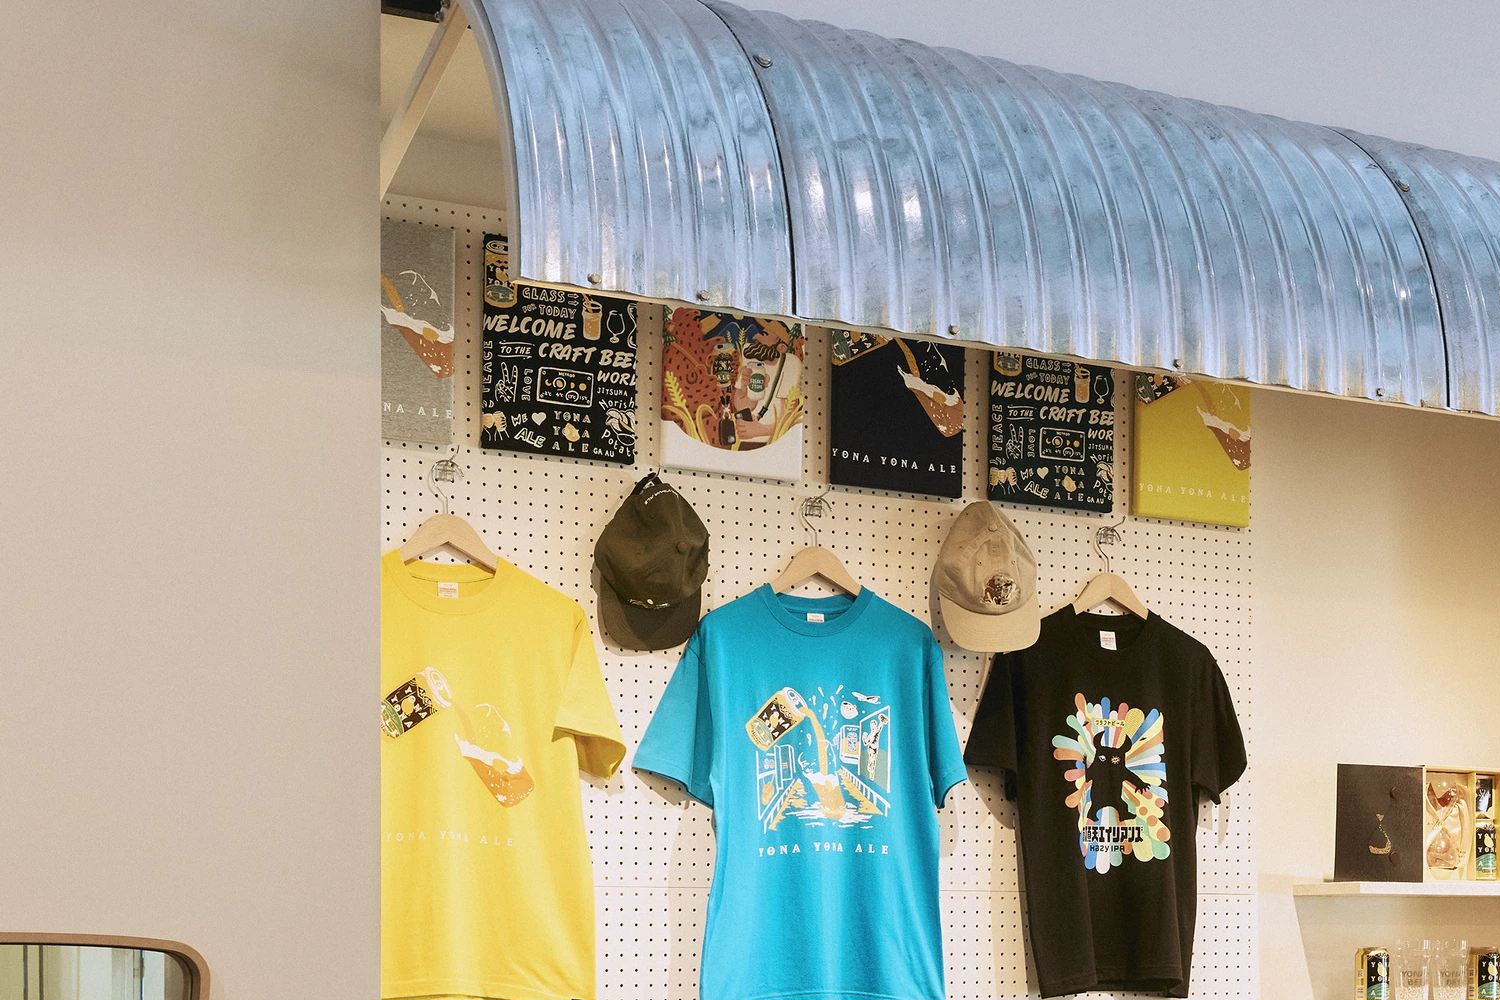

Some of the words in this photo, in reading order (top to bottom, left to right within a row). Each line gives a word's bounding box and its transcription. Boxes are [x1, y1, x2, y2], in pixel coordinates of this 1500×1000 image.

[522, 287, 566, 303] GLASS
[538, 304, 577, 320] TODAY
[483, 313, 577, 341] WELCOME
[500, 345, 512, 354] TO
[515, 346, 531, 355] THE
[538, 342, 597, 364] CRAFT
[1026, 358, 1060, 371] GLASS
[521, 368, 534, 402] LOVE
[1040, 373, 1070, 385] TODAY
[991, 380, 1070, 403] WELCOME
[418, 406, 452, 419] ALE
[553, 410, 591, 424] YONA
[1008, 409, 1018, 417] TO
[1020, 409, 1034, 417] THE
[1040, 406, 1086, 423] CRAFT
[511, 413, 528, 427] WE
[552, 425, 590, 438] YA
[992, 404, 1003, 451] PEACE
[514, 428, 546, 448] ALE
[552, 441, 589, 453] ALE
[832, 448, 870, 463] YONA
[880, 456, 918, 470] YONA
[928, 463, 956, 474] ALE
[1020, 468, 1034, 480] WE
[1054, 465, 1085, 476] YONA
[1024, 481, 1049, 499] ALE
[1054, 479, 1084, 489] YA
[1054, 492, 1084, 502] ALE
[1139, 483, 1171, 493] YONA
[1181, 486, 1212, 498] YONA
[1221, 492, 1246, 503] ALE
[1094, 719, 1125, 727] クラフトビール
[386, 831, 426, 842] YONA
[480, 835, 514, 847] ALE
[759, 844, 801, 857] YONA
[855, 844, 889, 855] ALE
[1090, 845, 1109, 853] Hazy
